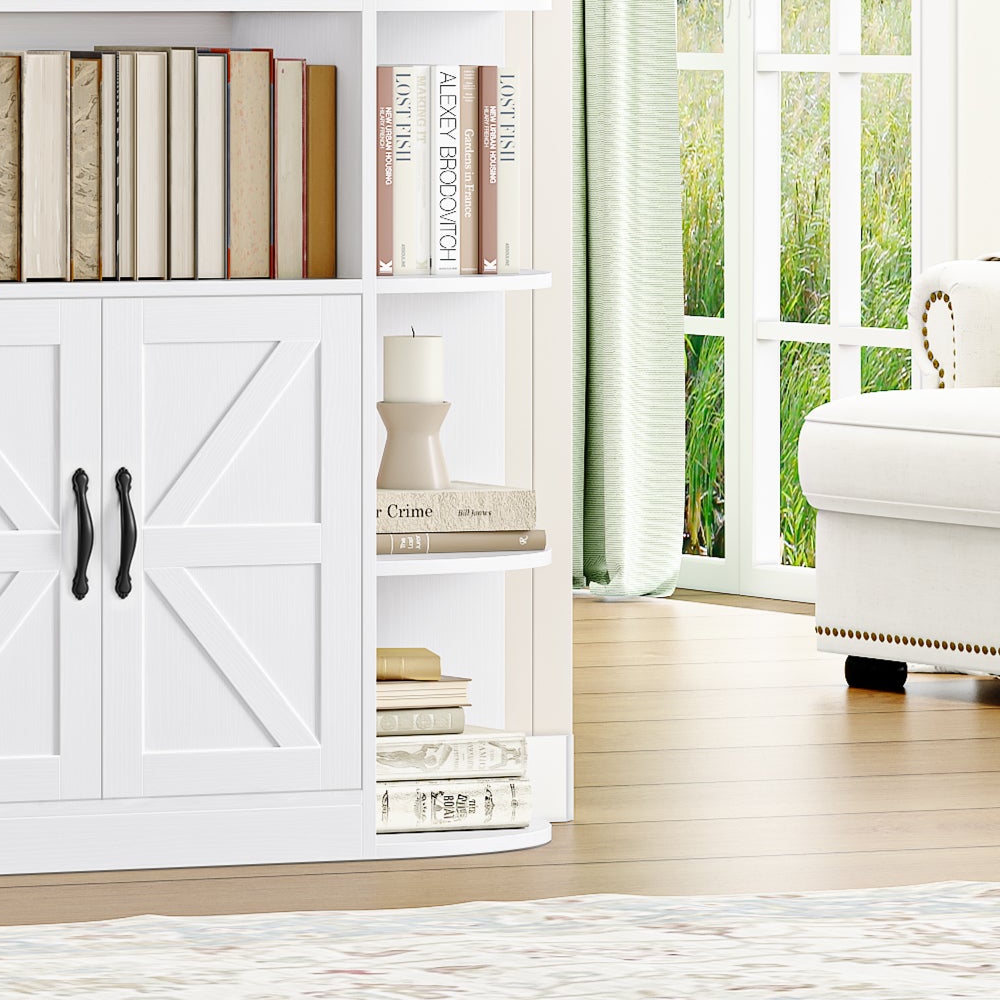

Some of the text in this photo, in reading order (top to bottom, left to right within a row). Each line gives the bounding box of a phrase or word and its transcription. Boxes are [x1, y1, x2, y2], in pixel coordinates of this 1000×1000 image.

[395, 73, 411, 161] LOST FISH
[439, 71, 457, 140] ALEXEY
[500, 75, 515, 161] LOST FISH
[439, 146, 457, 261] BRODOVITCH
[463, 129, 475, 218] Gardens in France
[387, 504, 433, 518] Crime
[458, 508, 469, 517] Bill
[468, 798, 476, 814] THE
